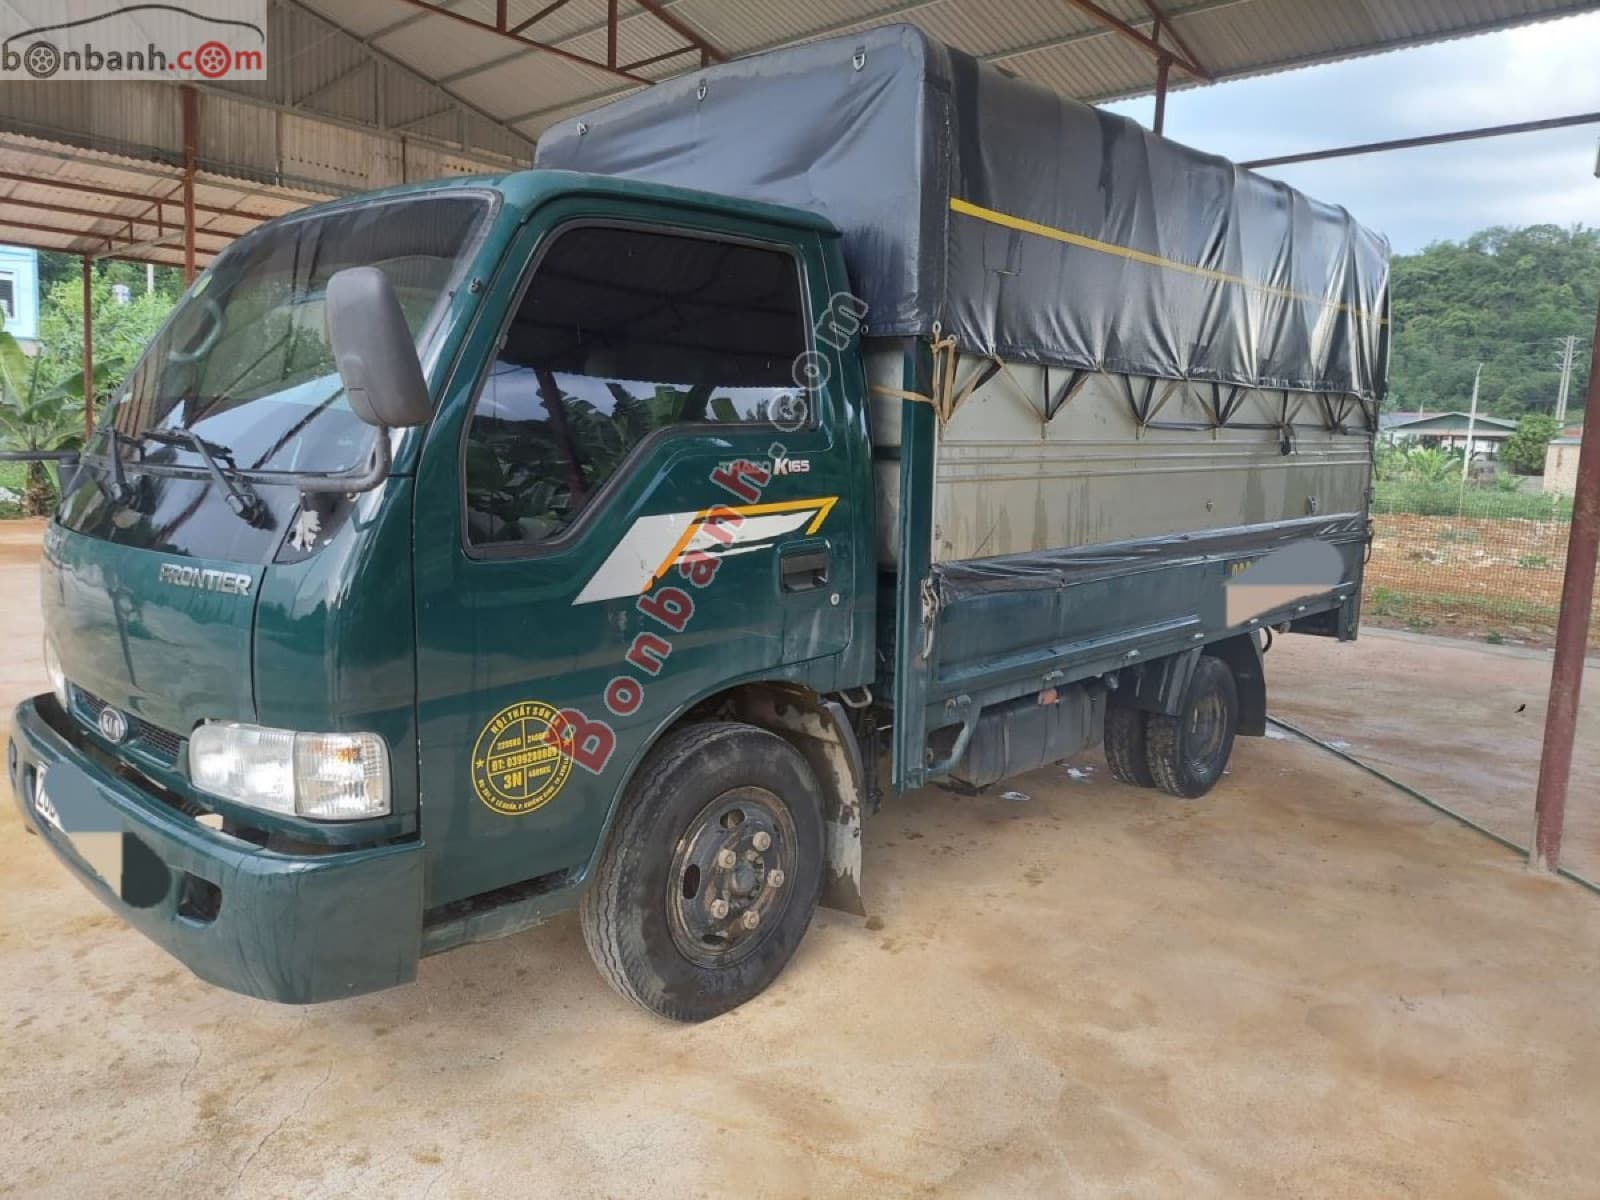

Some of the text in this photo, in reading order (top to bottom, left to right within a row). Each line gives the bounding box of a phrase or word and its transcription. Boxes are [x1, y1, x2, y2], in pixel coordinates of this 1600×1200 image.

[773, 457, 811, 476] K165
[159, 563, 252, 596] FRONTIER
[503, 771, 523, 790] 3N
